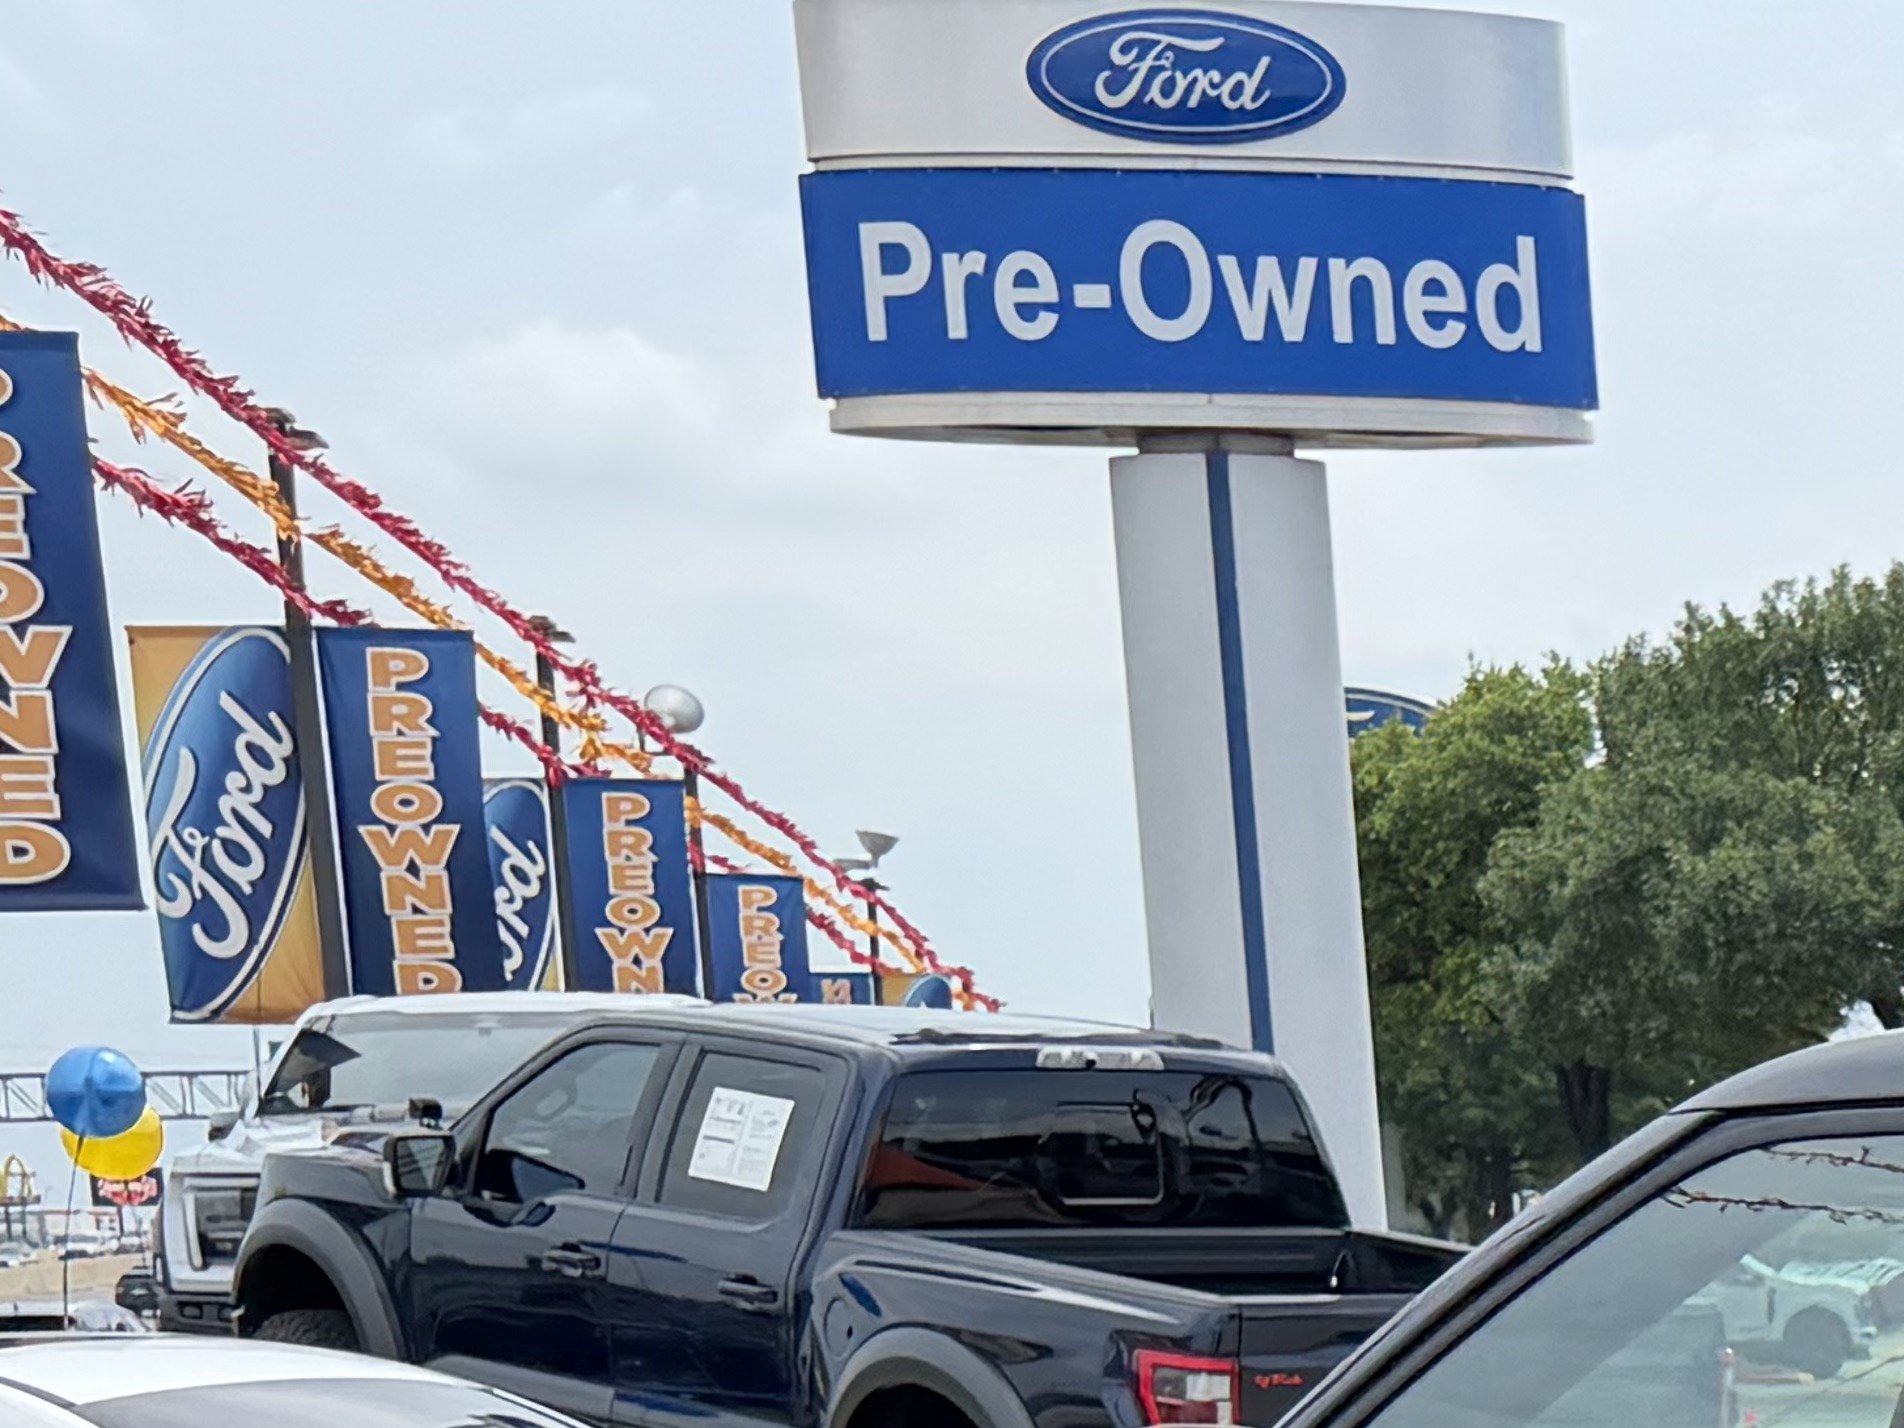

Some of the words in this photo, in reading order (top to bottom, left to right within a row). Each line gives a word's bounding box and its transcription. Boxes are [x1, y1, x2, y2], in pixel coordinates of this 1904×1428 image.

[1094, 29, 1271, 112] Ford
[857, 218, 1544, 354] Pre-Owned
[151, 689, 295, 959] Ford
[357, 646, 463, 994] PREOWNED
[594, 791, 674, 994] PREOWN
